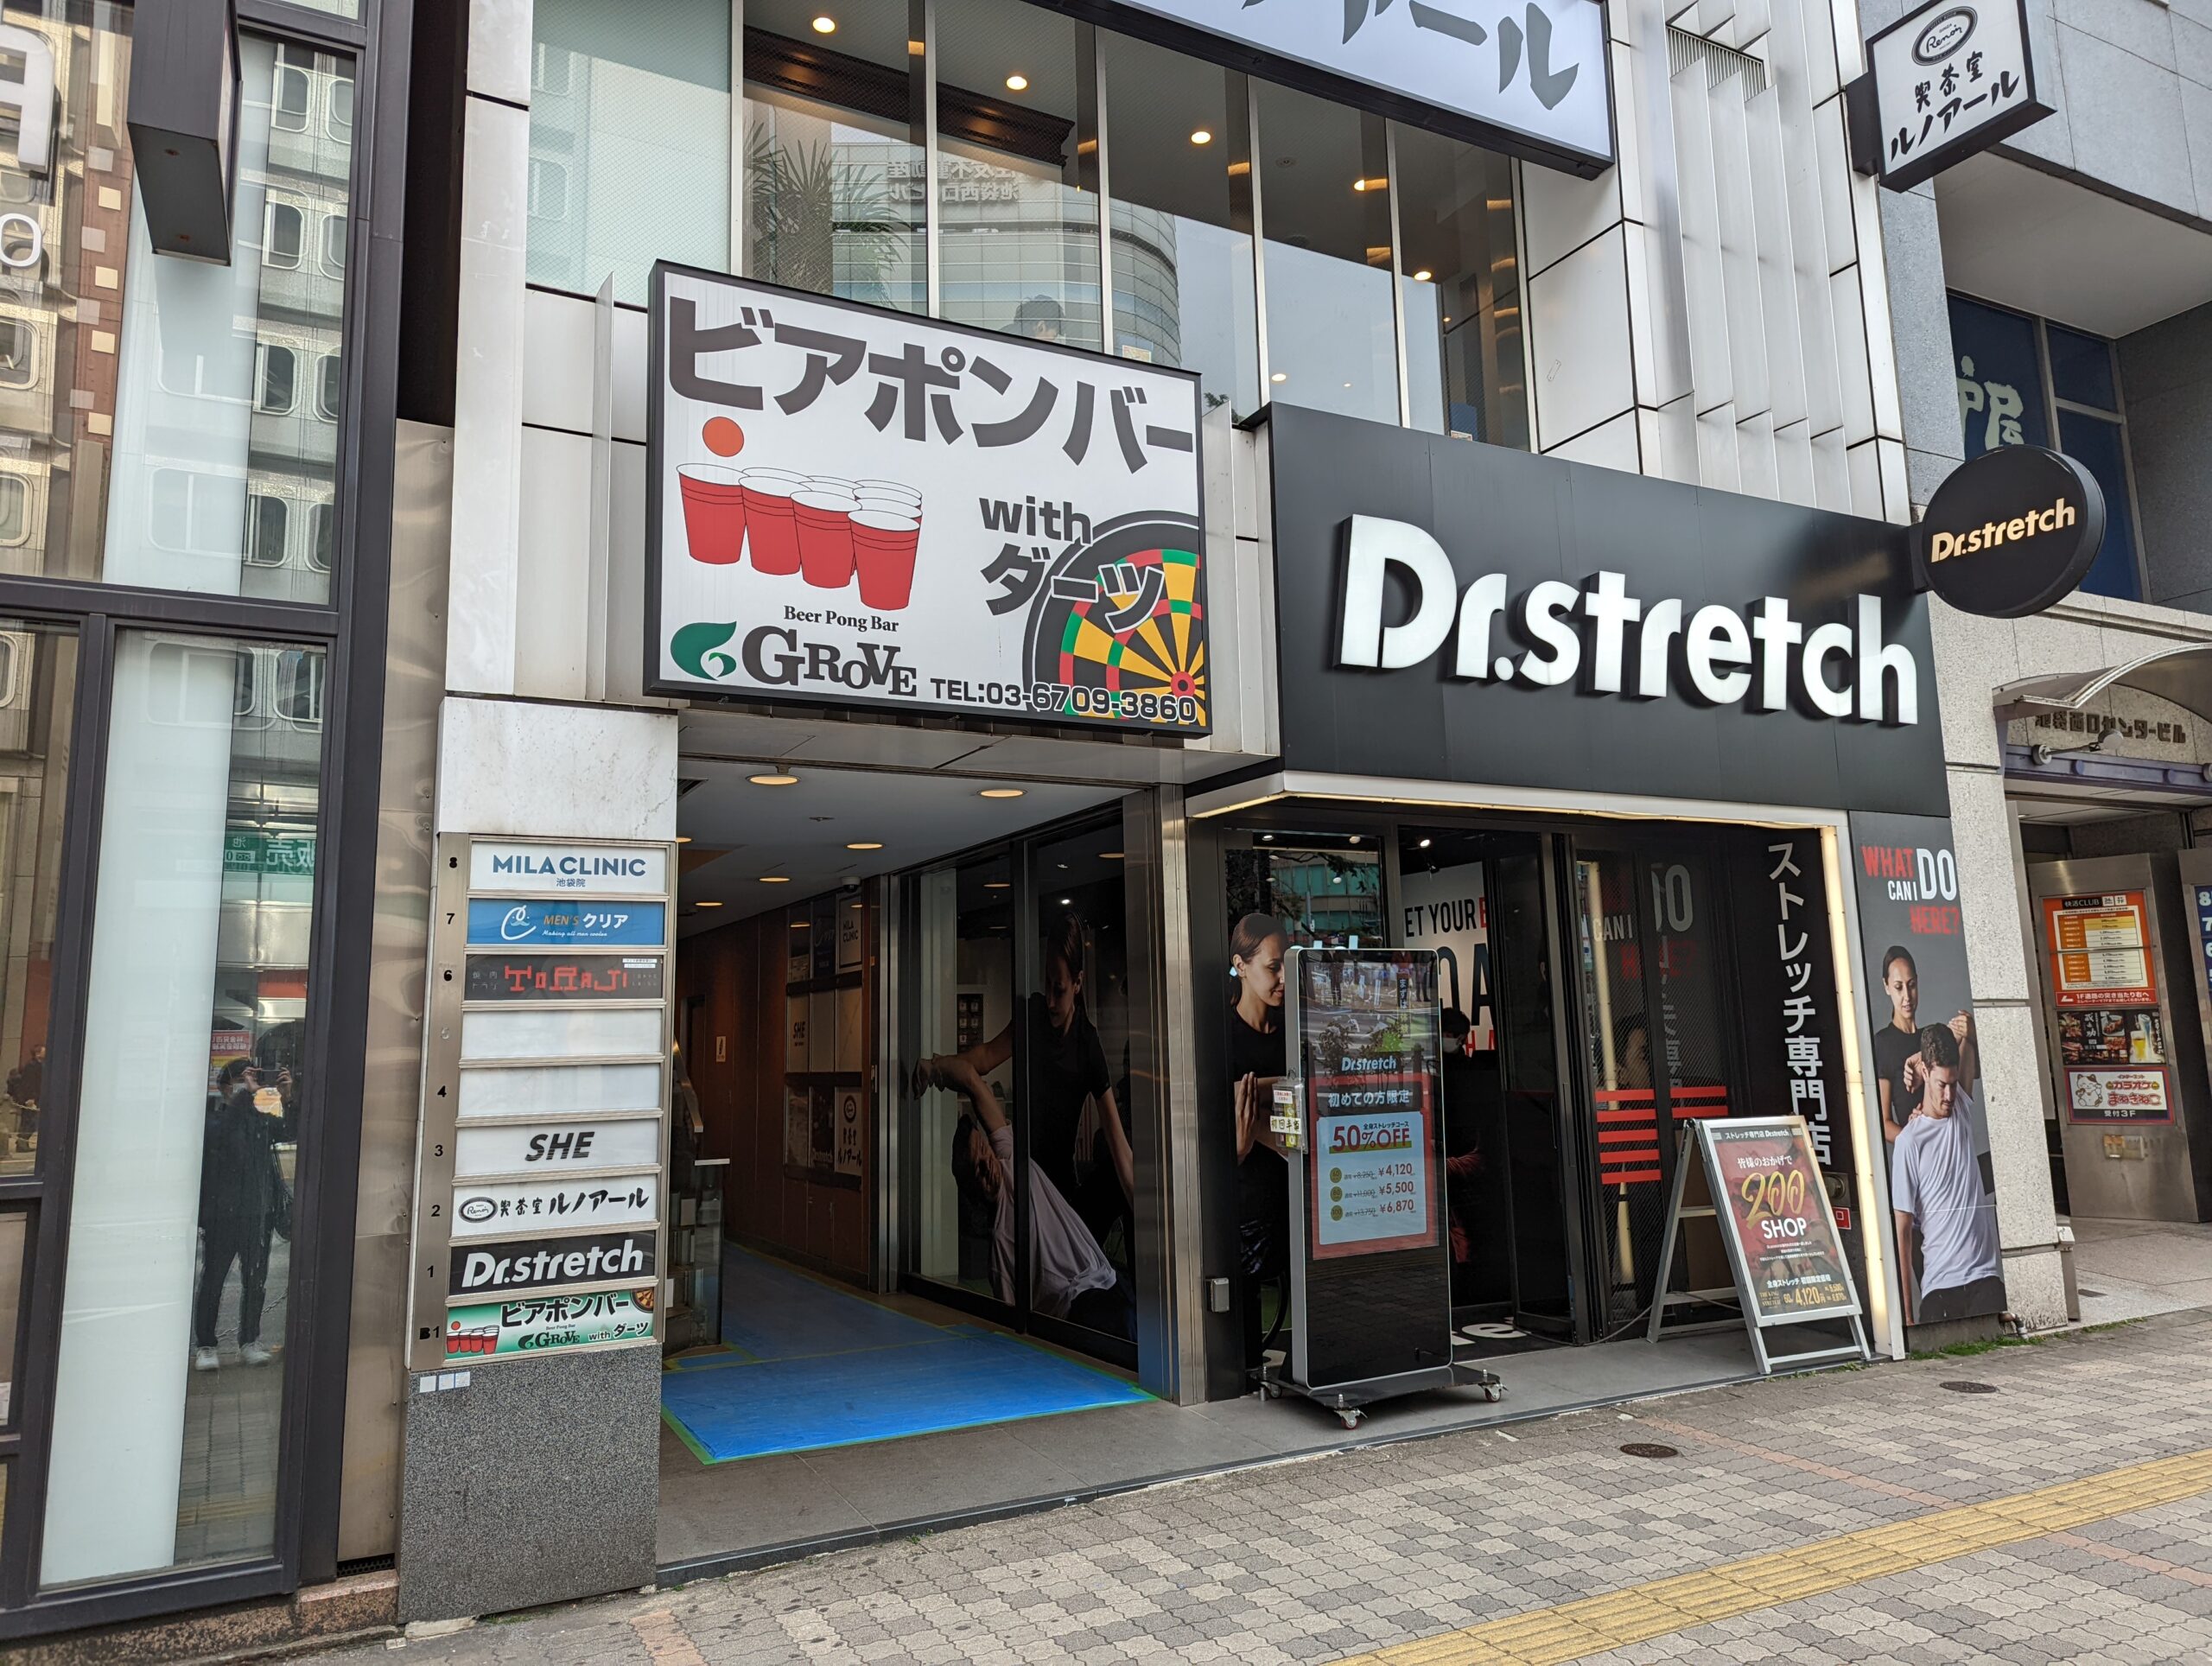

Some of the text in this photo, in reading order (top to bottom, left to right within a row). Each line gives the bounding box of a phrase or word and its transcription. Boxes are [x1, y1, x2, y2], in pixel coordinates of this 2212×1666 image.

[1915, 50, 1983, 113] 喫茶室
[1891, 70, 2020, 162] ルノアール
[669, 296, 1194, 475] ビアポンバー
[979, 495, 1095, 546] with
[1931, 498, 2075, 563] Dr.stretch
[980, 545, 1165, 633] ダーツ
[784, 604, 899, 633] Beer Pong Bar
[1338, 512, 1918, 726] Dr.stretch
[741, 625, 918, 697] GROVE
[556, 877, 586, 888] 池袋院
[1861, 846, 1957, 901] WHAT DO
[1887, 881, 1912, 901] CAN
[2198, 891, 2212, 906] 8
[447, 912, 455, 925] 7
[582, 912, 628, 929] クリア
[1428, 899, 1476, 935] YOUR
[1910, 905, 1960, 935] HERE?
[443, 970, 453, 982] 6
[1767, 842, 1832, 1167] ストレッチ専門店
[1341, 1056, 1396, 1071] Dr.stretch
[437, 1085, 447, 1097] 4
[1328, 1090, 1410, 1108] 初めての方限定
[435, 1144, 443, 1156] 3
[524, 1130, 595, 1162] SHE
[1737, 1154, 1793, 1169] 皆様のおかげで
[1379, 1181, 1414, 1195] ¥5,500
[1741, 1169, 1805, 1230] 200
[431, 1205, 441, 1217] 2
[499, 1186, 650, 1218] 喫茶室 ルノアール
[1380, 1199, 1414, 1214] ¥6,870
[1761, 1217, 1808, 1240] SHOP
[427, 1265, 435, 1278] 1
[461, 1238, 644, 1288] Dr.stretch
[500, 1292, 629, 1328] ビアポンバー
[535, 1330, 580, 1348] GROVE
[588, 1321, 649, 1341] with ダーツ
